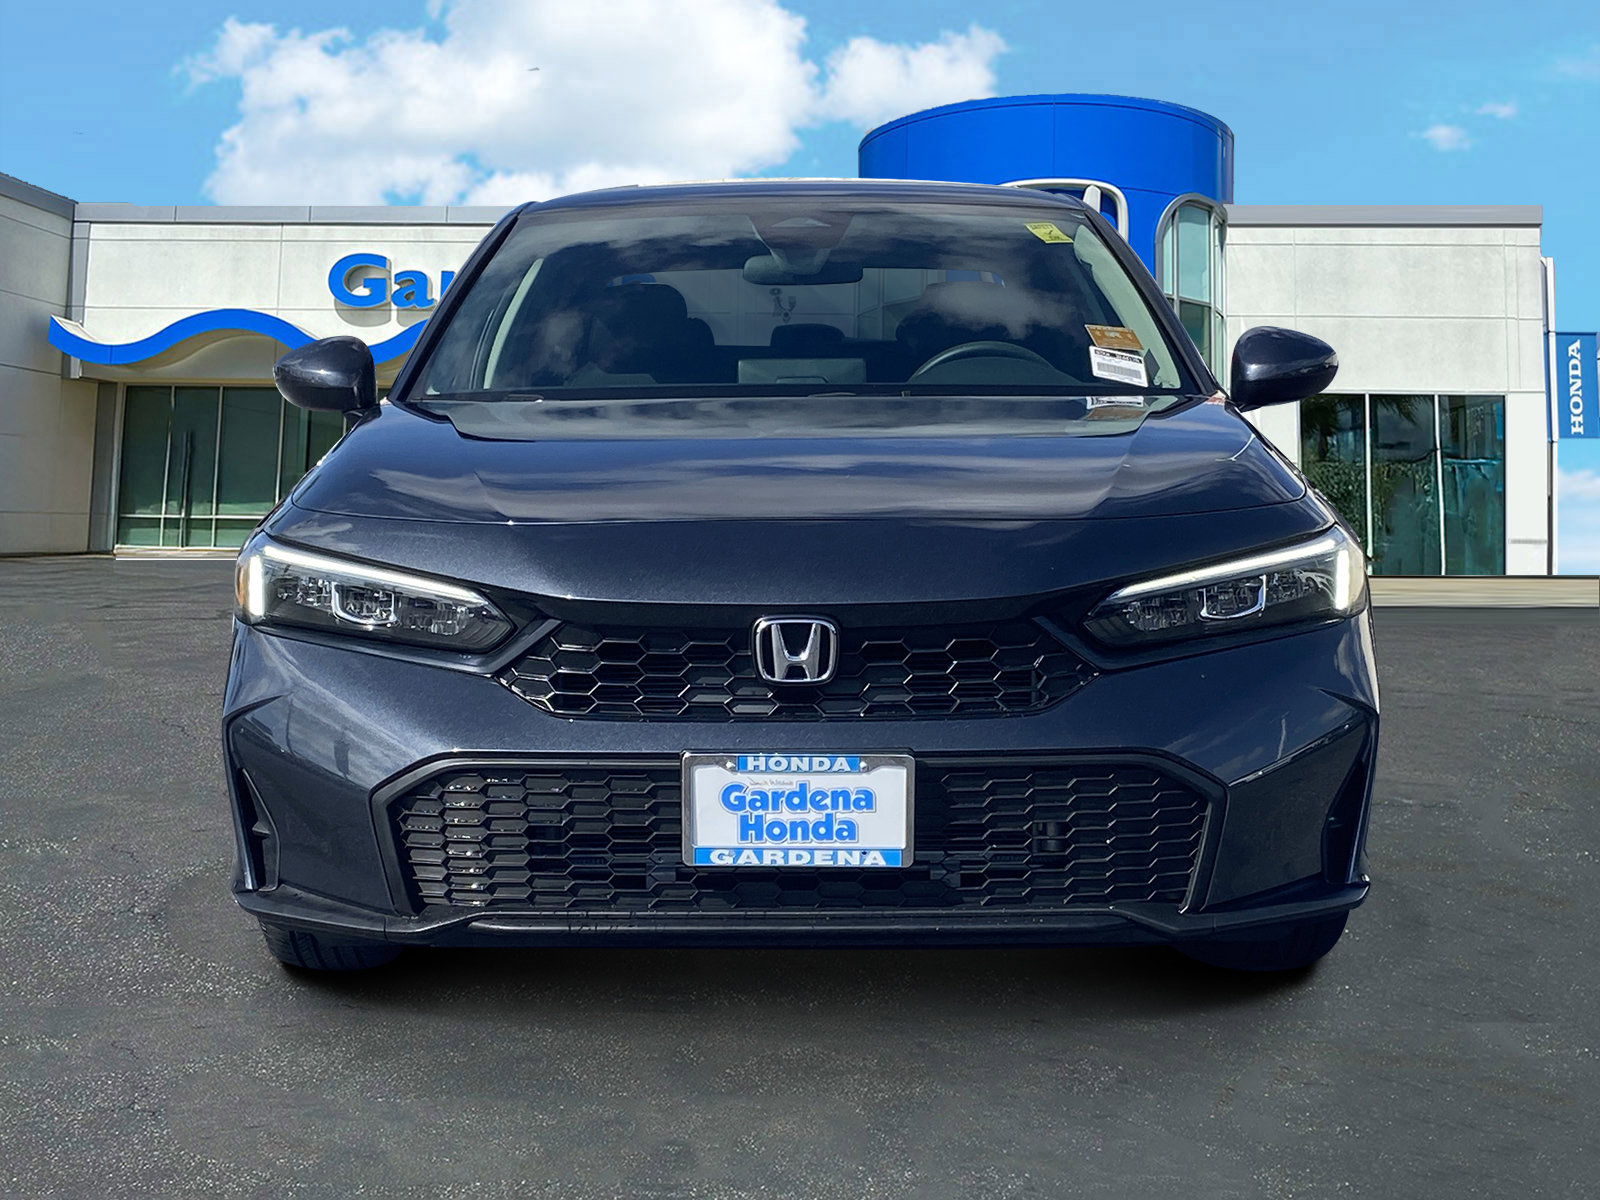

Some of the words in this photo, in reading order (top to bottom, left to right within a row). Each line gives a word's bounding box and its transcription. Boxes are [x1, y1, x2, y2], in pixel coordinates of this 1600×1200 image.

[1568, 339, 1584, 435] HONDA
[747, 756, 851, 772] HONDA
[720, 782, 875, 812] Gardena
[739, 813, 857, 842] Honda
[710, 850, 887, 865] GARDENA
